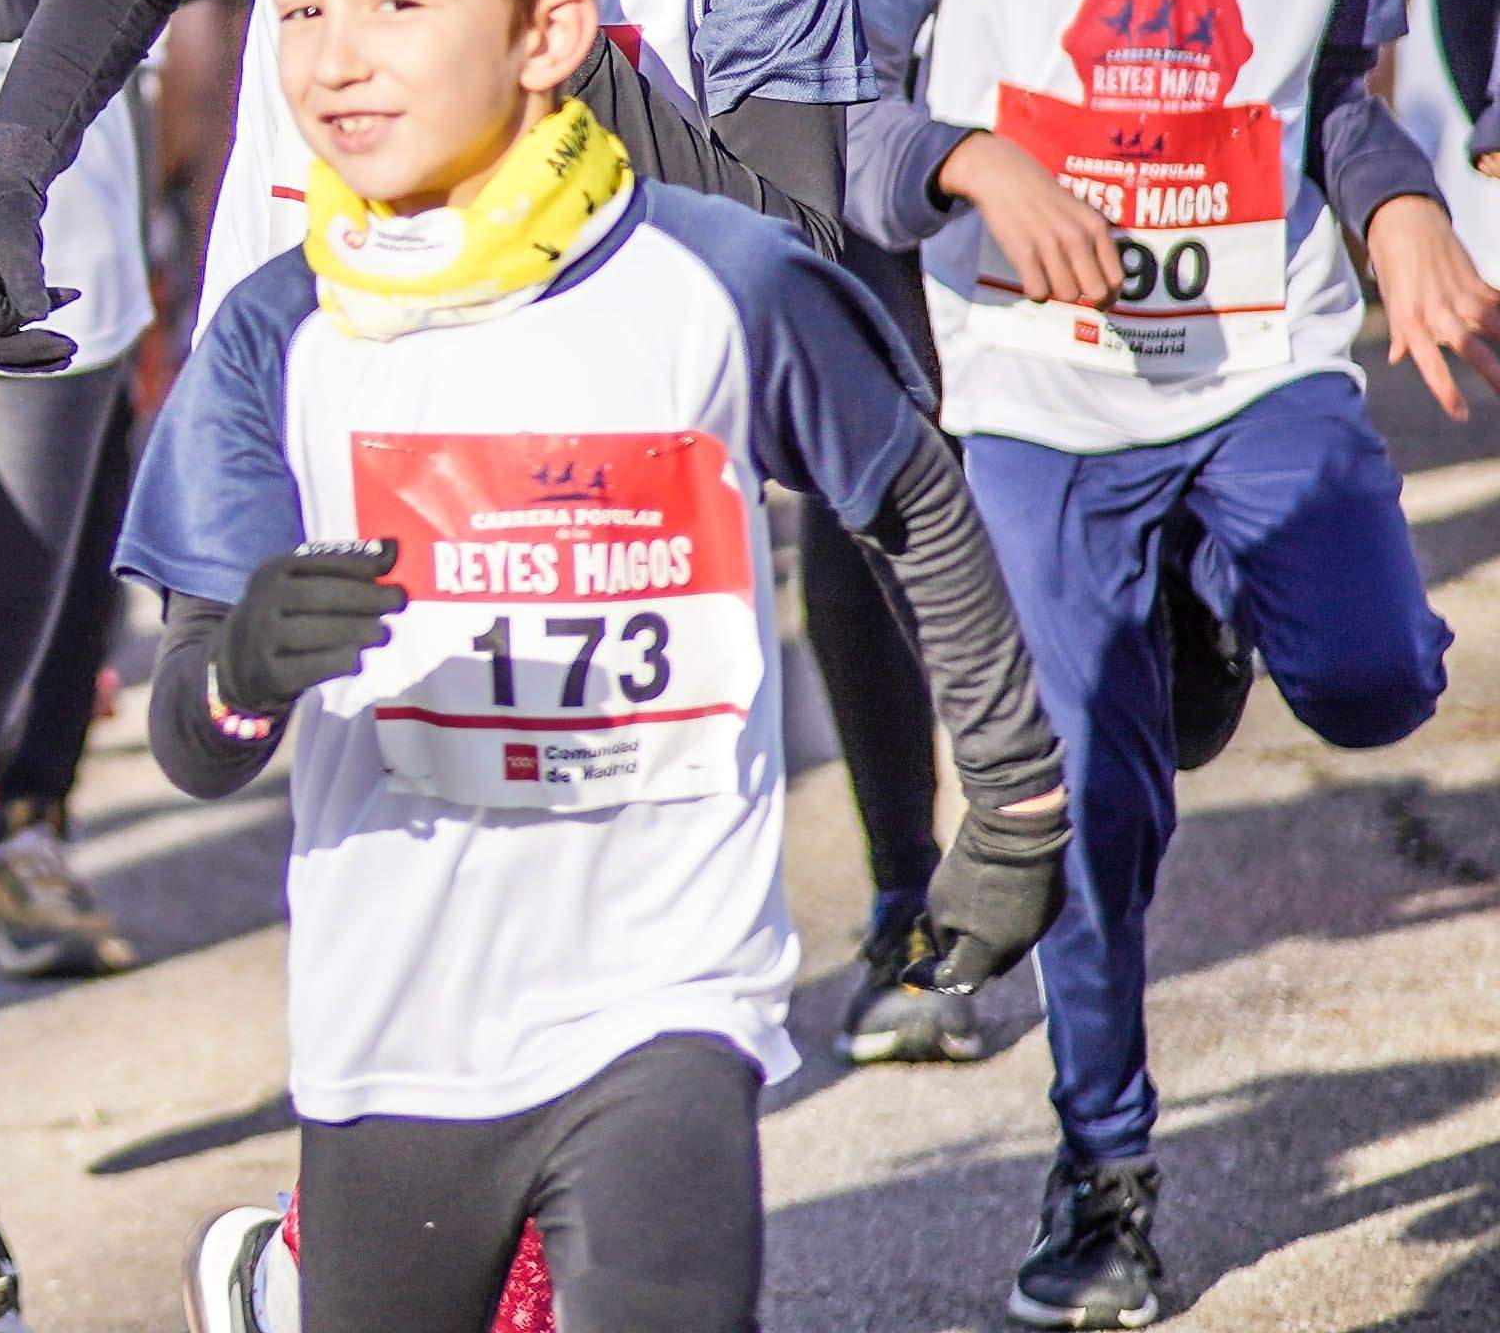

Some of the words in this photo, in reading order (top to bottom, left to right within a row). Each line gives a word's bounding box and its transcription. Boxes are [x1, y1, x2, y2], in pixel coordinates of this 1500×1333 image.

[1093, 65, 1155, 96] REYES
[1064, 154, 1136, 179] CARRERA
[1139, 161, 1207, 182] POPULAR
[1135, 181, 1229, 228] MAGOS
[1106, 322, 1187, 339] Comunidad
[1129, 339, 1186, 356] Madrid
[470, 509, 573, 530] CARRERA
[574, 508, 664, 528] POPULAR
[432, 538, 559, 596] REYES
[572, 535, 693, 596] MAGOS
[472, 611, 671, 708] 173
[544, 740, 639, 760] Comunidad
[545, 768, 572, 783] de
[581, 759, 638, 781] Madrid
